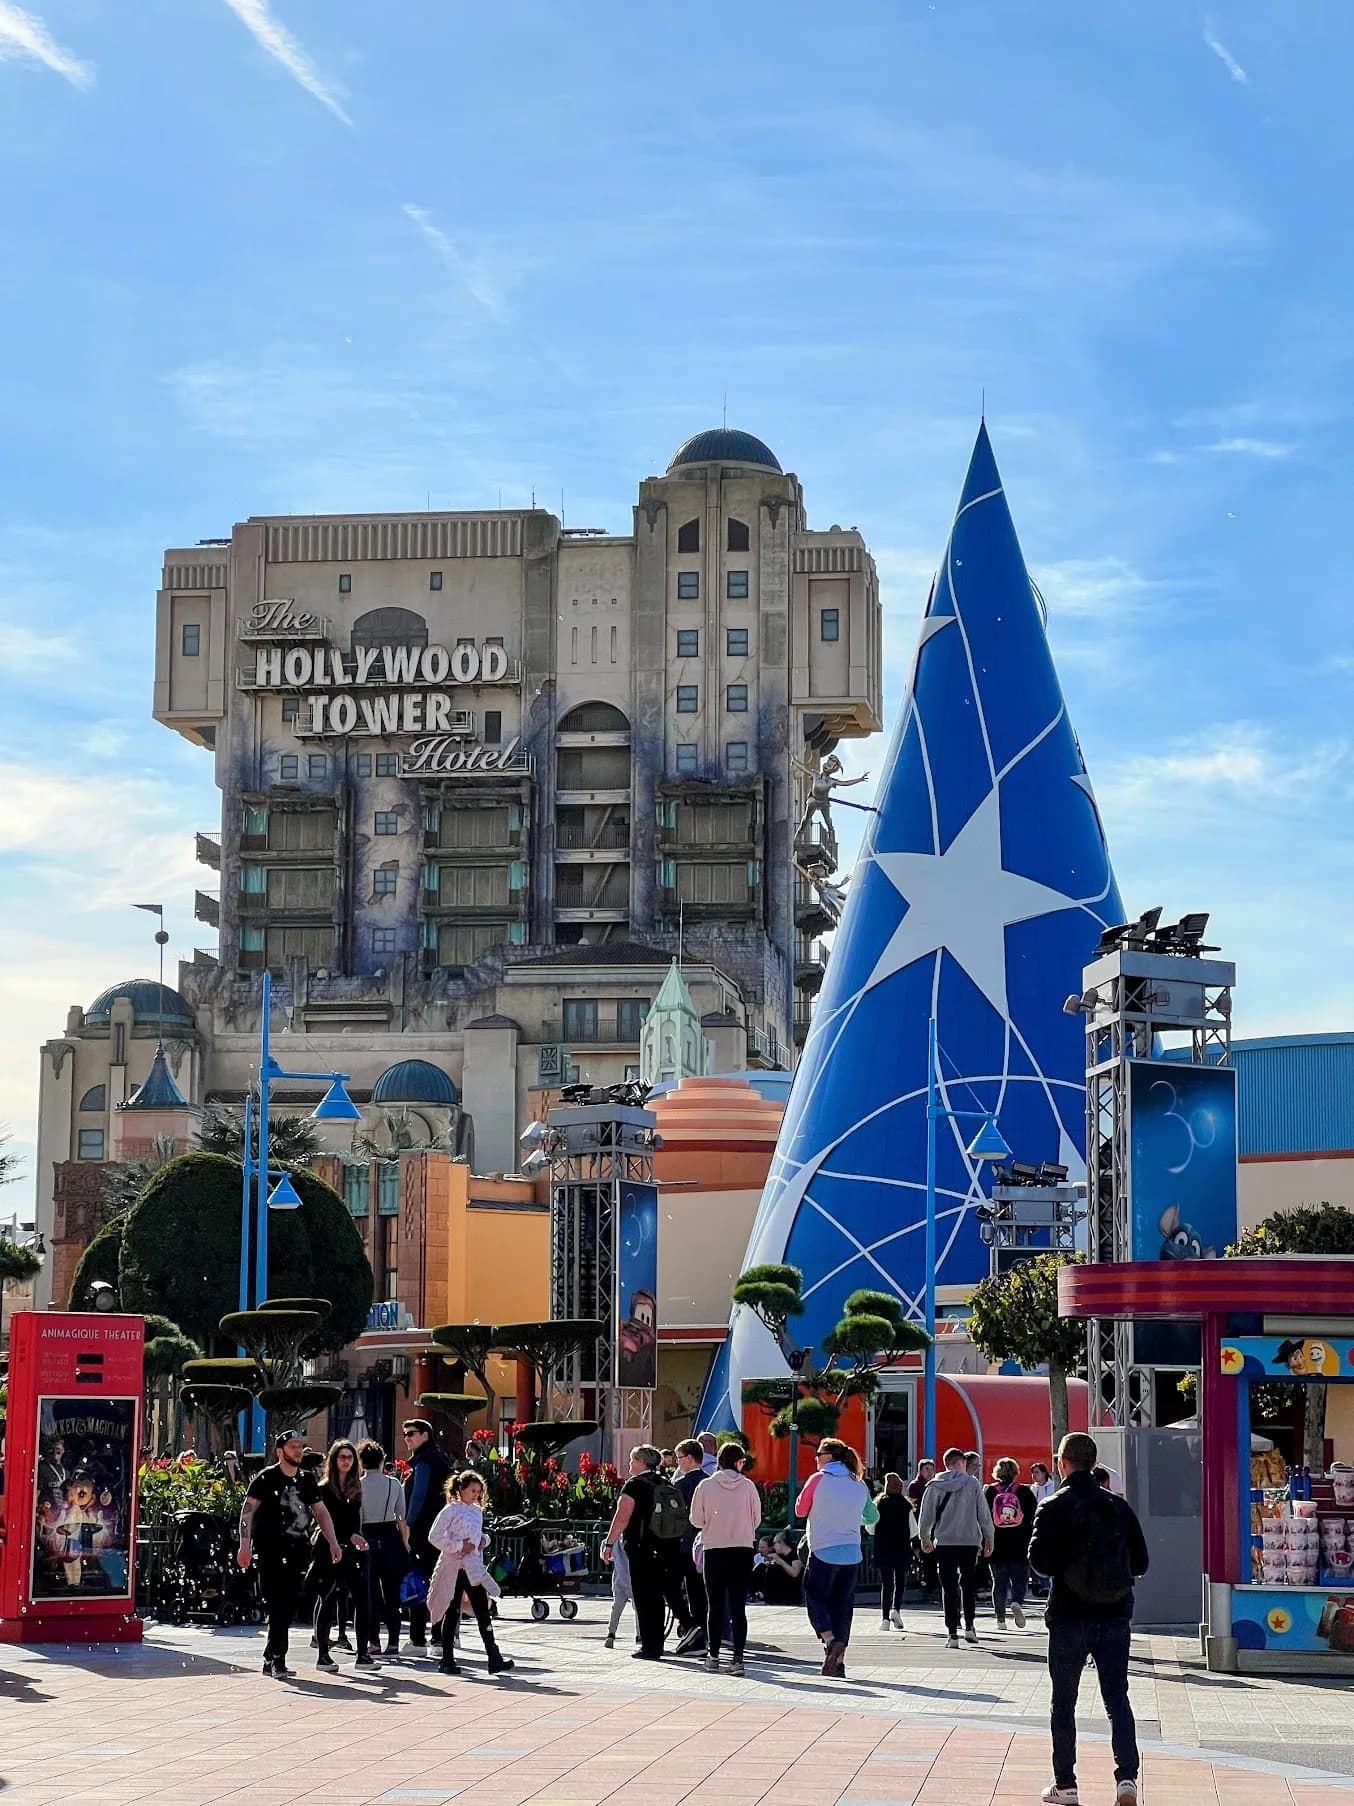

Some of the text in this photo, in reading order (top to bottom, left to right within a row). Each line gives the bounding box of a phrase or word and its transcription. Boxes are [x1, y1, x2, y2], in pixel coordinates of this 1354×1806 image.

[246, 599, 317, 631] The
[256, 644, 508, 687] HOLLYWOOD
[308, 693, 452, 735] TOWER
[404, 735, 521, 772] Hotel
[1149, 1080, 1216, 1174] 30
[41, 1328, 141, 1341] ANIMAGIQUE THEATER
